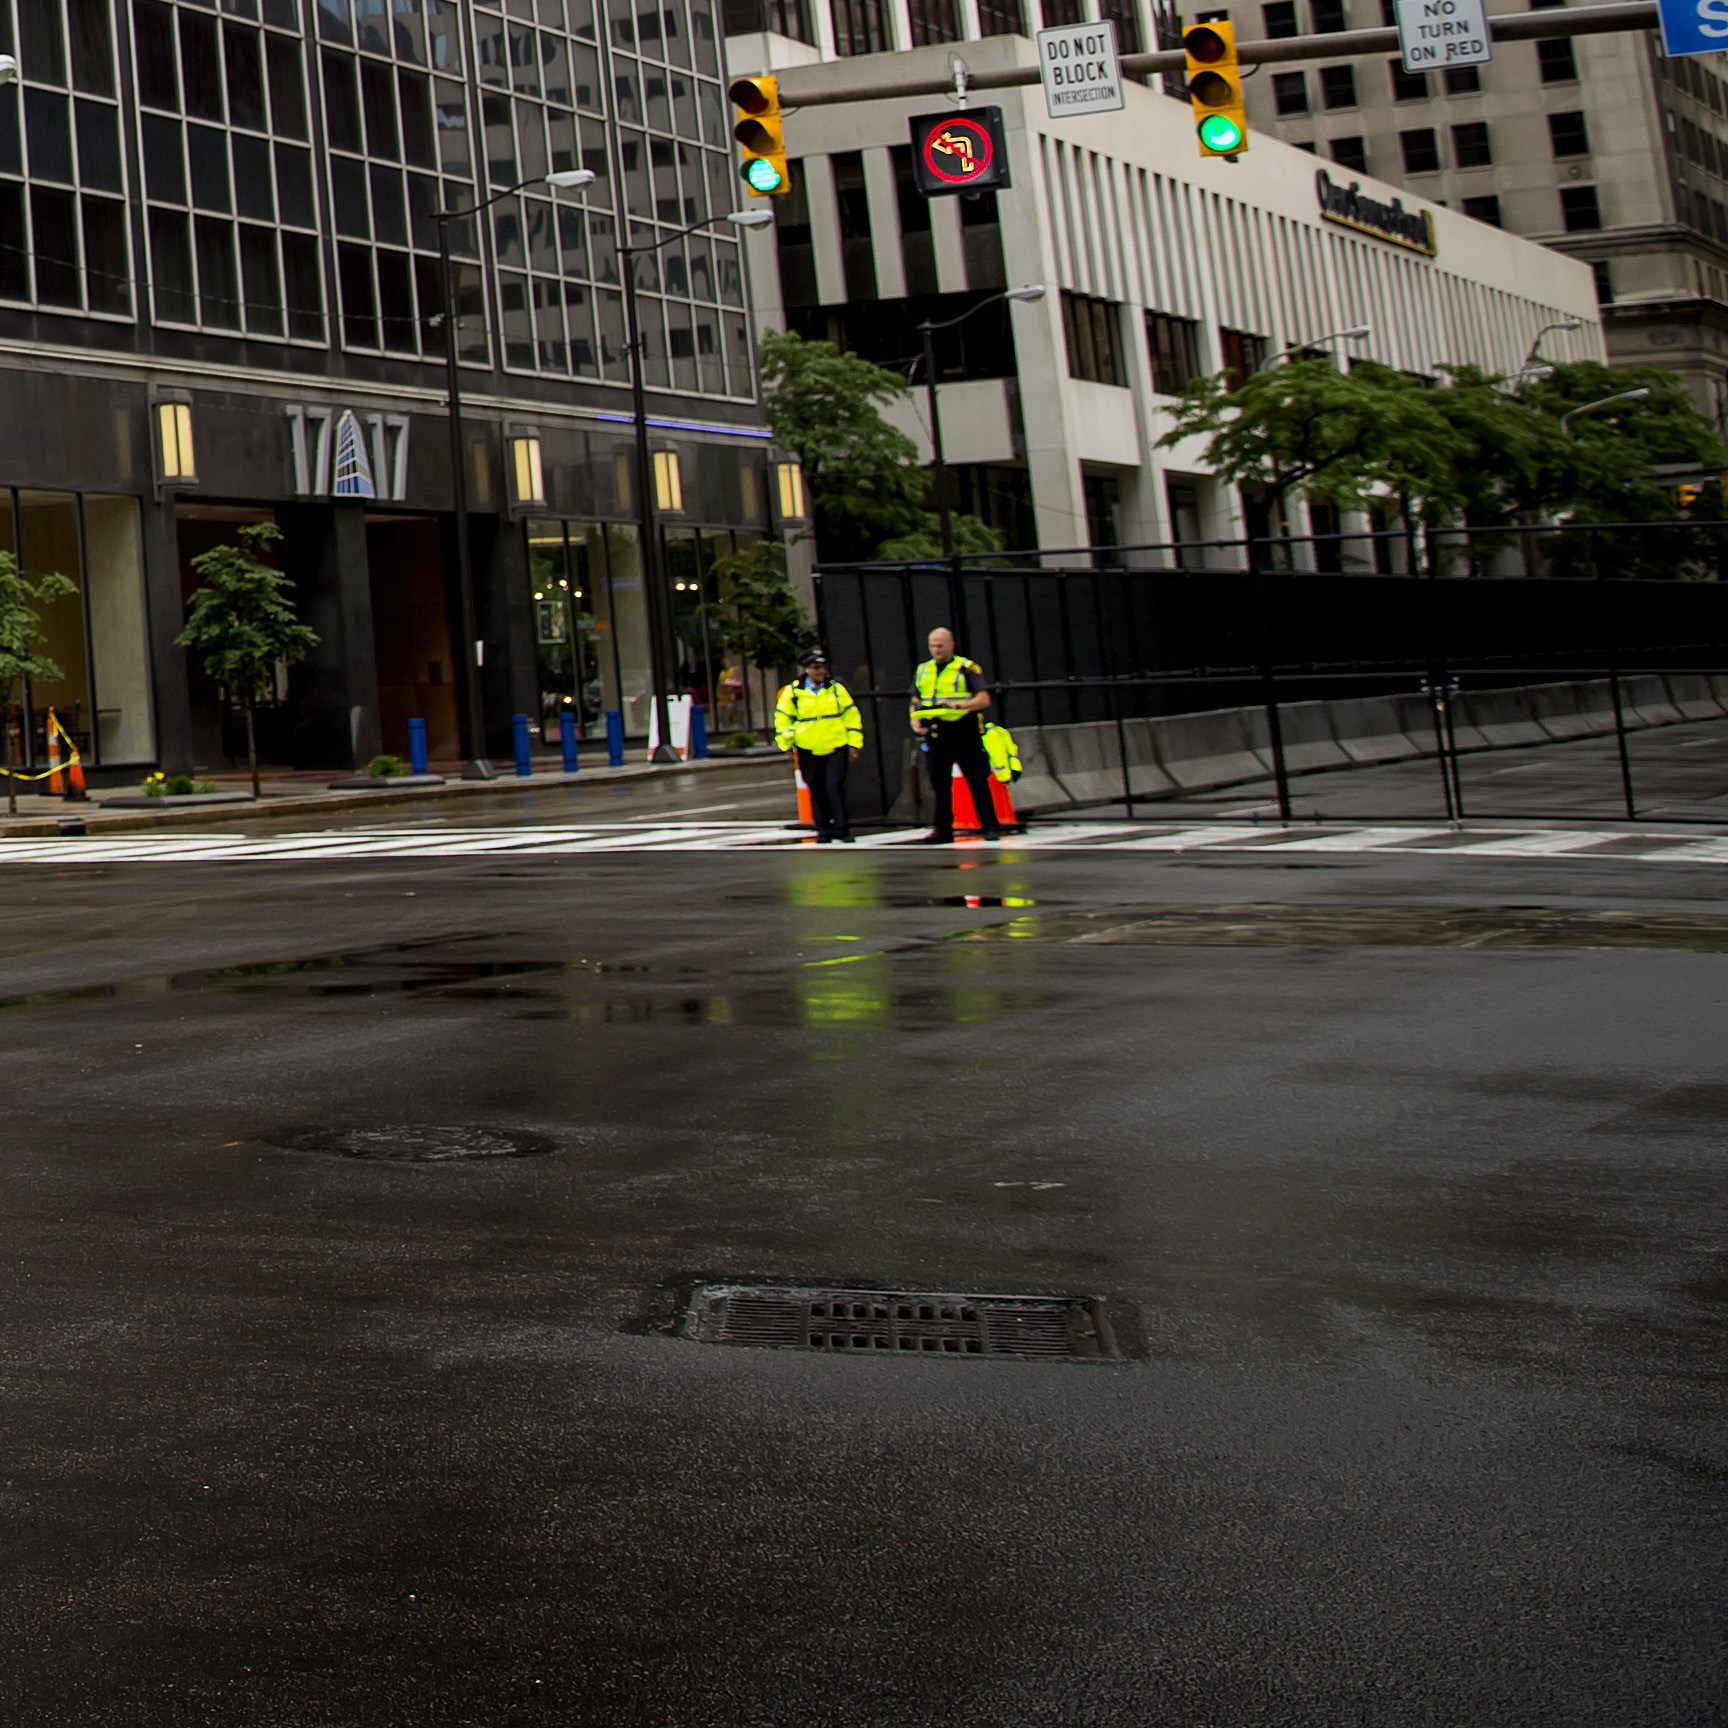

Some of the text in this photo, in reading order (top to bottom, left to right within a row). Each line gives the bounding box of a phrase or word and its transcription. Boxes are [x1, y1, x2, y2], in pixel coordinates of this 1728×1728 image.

[1423, 0, 1456, 18] NO
[1417, 19, 1470, 39] TURN
[1047, 34, 1105, 60] DO NOT
[1410, 39, 1484, 61] ON RED
[1053, 61, 1108, 86] BLOCK
[1052, 86, 1116, 105] INTERSECTION
